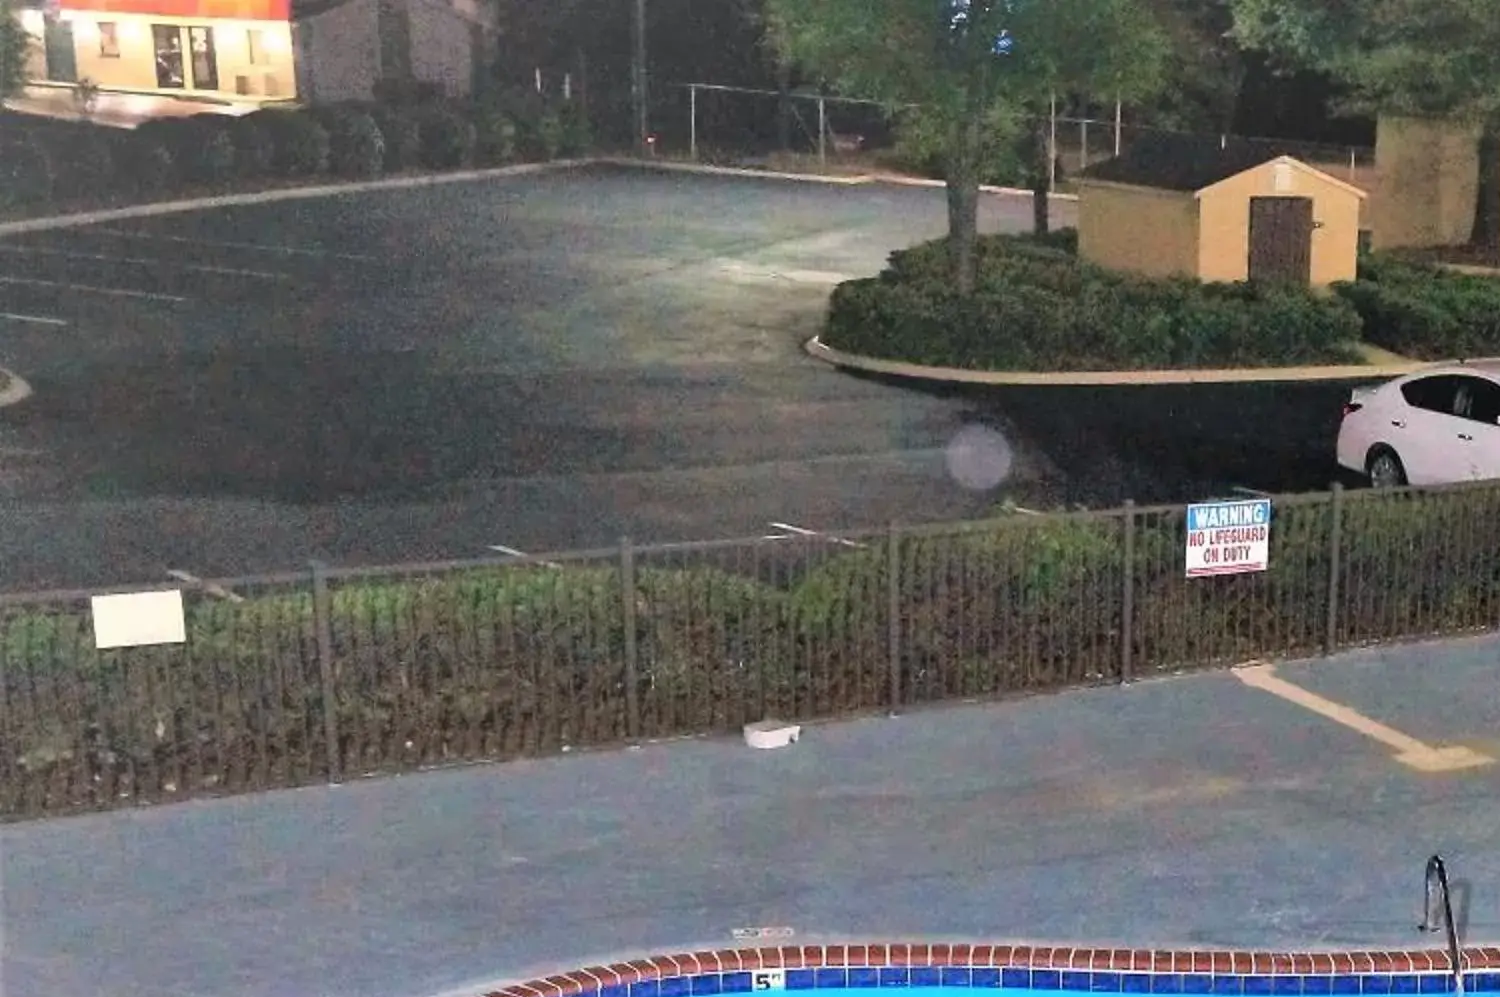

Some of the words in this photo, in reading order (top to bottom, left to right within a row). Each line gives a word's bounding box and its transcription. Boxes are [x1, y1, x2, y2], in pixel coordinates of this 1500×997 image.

[1195, 503, 1265, 527] WARNING
[1189, 531, 1205, 547] NO
[1209, 527, 1266, 545] LIFEGUARD
[1203, 548, 1219, 563] ON
[1223, 546, 1251, 562] DUTY
